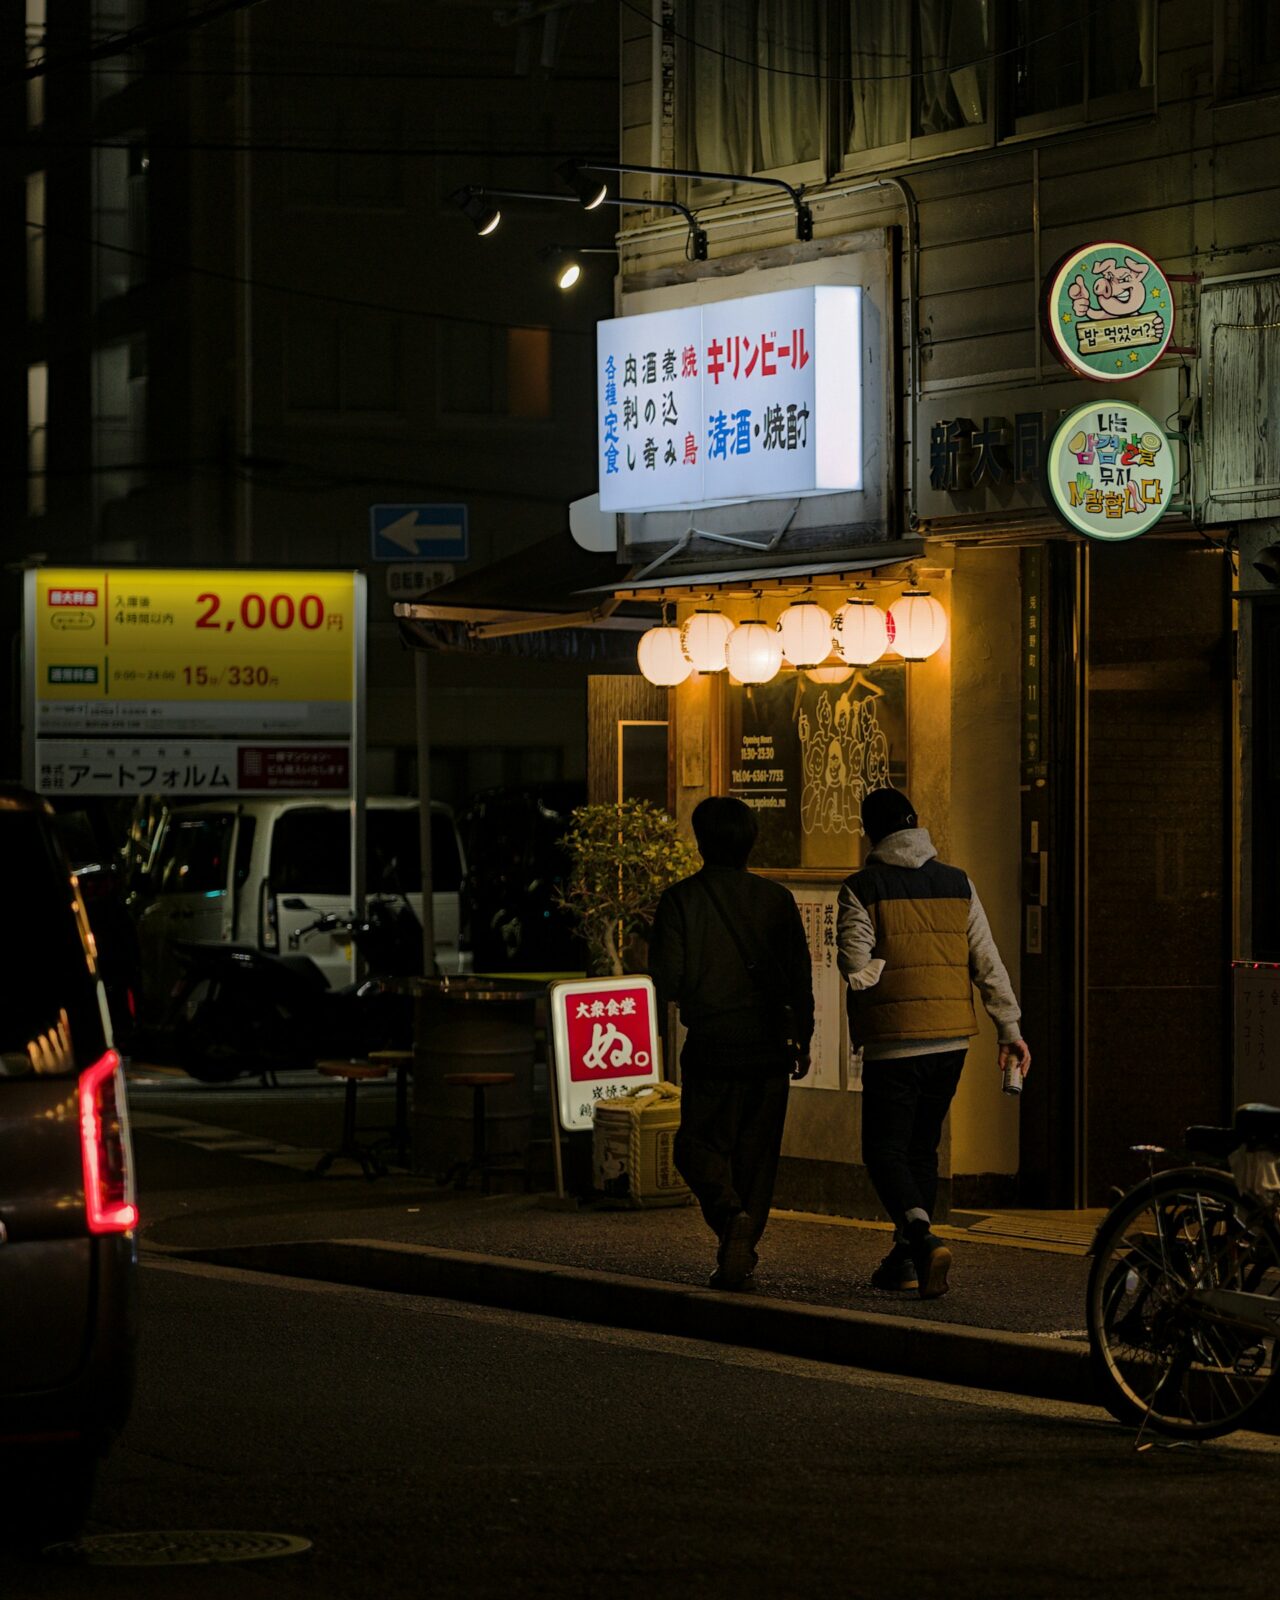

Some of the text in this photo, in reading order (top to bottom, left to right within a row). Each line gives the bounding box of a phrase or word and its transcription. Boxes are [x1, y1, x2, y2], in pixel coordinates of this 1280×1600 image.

[707, 328, 809, 385] キリンビール
[1084, 323, 1151, 347] 밥 먹었어?
[604, 355, 619, 474] 各種定食
[623, 353, 638, 471] 肉刺し
[642, 351, 659, 471] 酒の肴
[662, 349, 678, 466] 煮込み
[681, 344, 699, 466] 焼鳥
[708, 401, 810, 461] 清酒・焼酎
[1097, 413, 1128, 433] 나는
[930, 412, 1044, 491] 新大同
[1099, 466, 1131, 486] 무지
[1068, 471, 1163, 519] 사랑합니다
[68, 765, 230, 788] アートフォルム
[576, 997, 637, 1019] 大衆食堂
